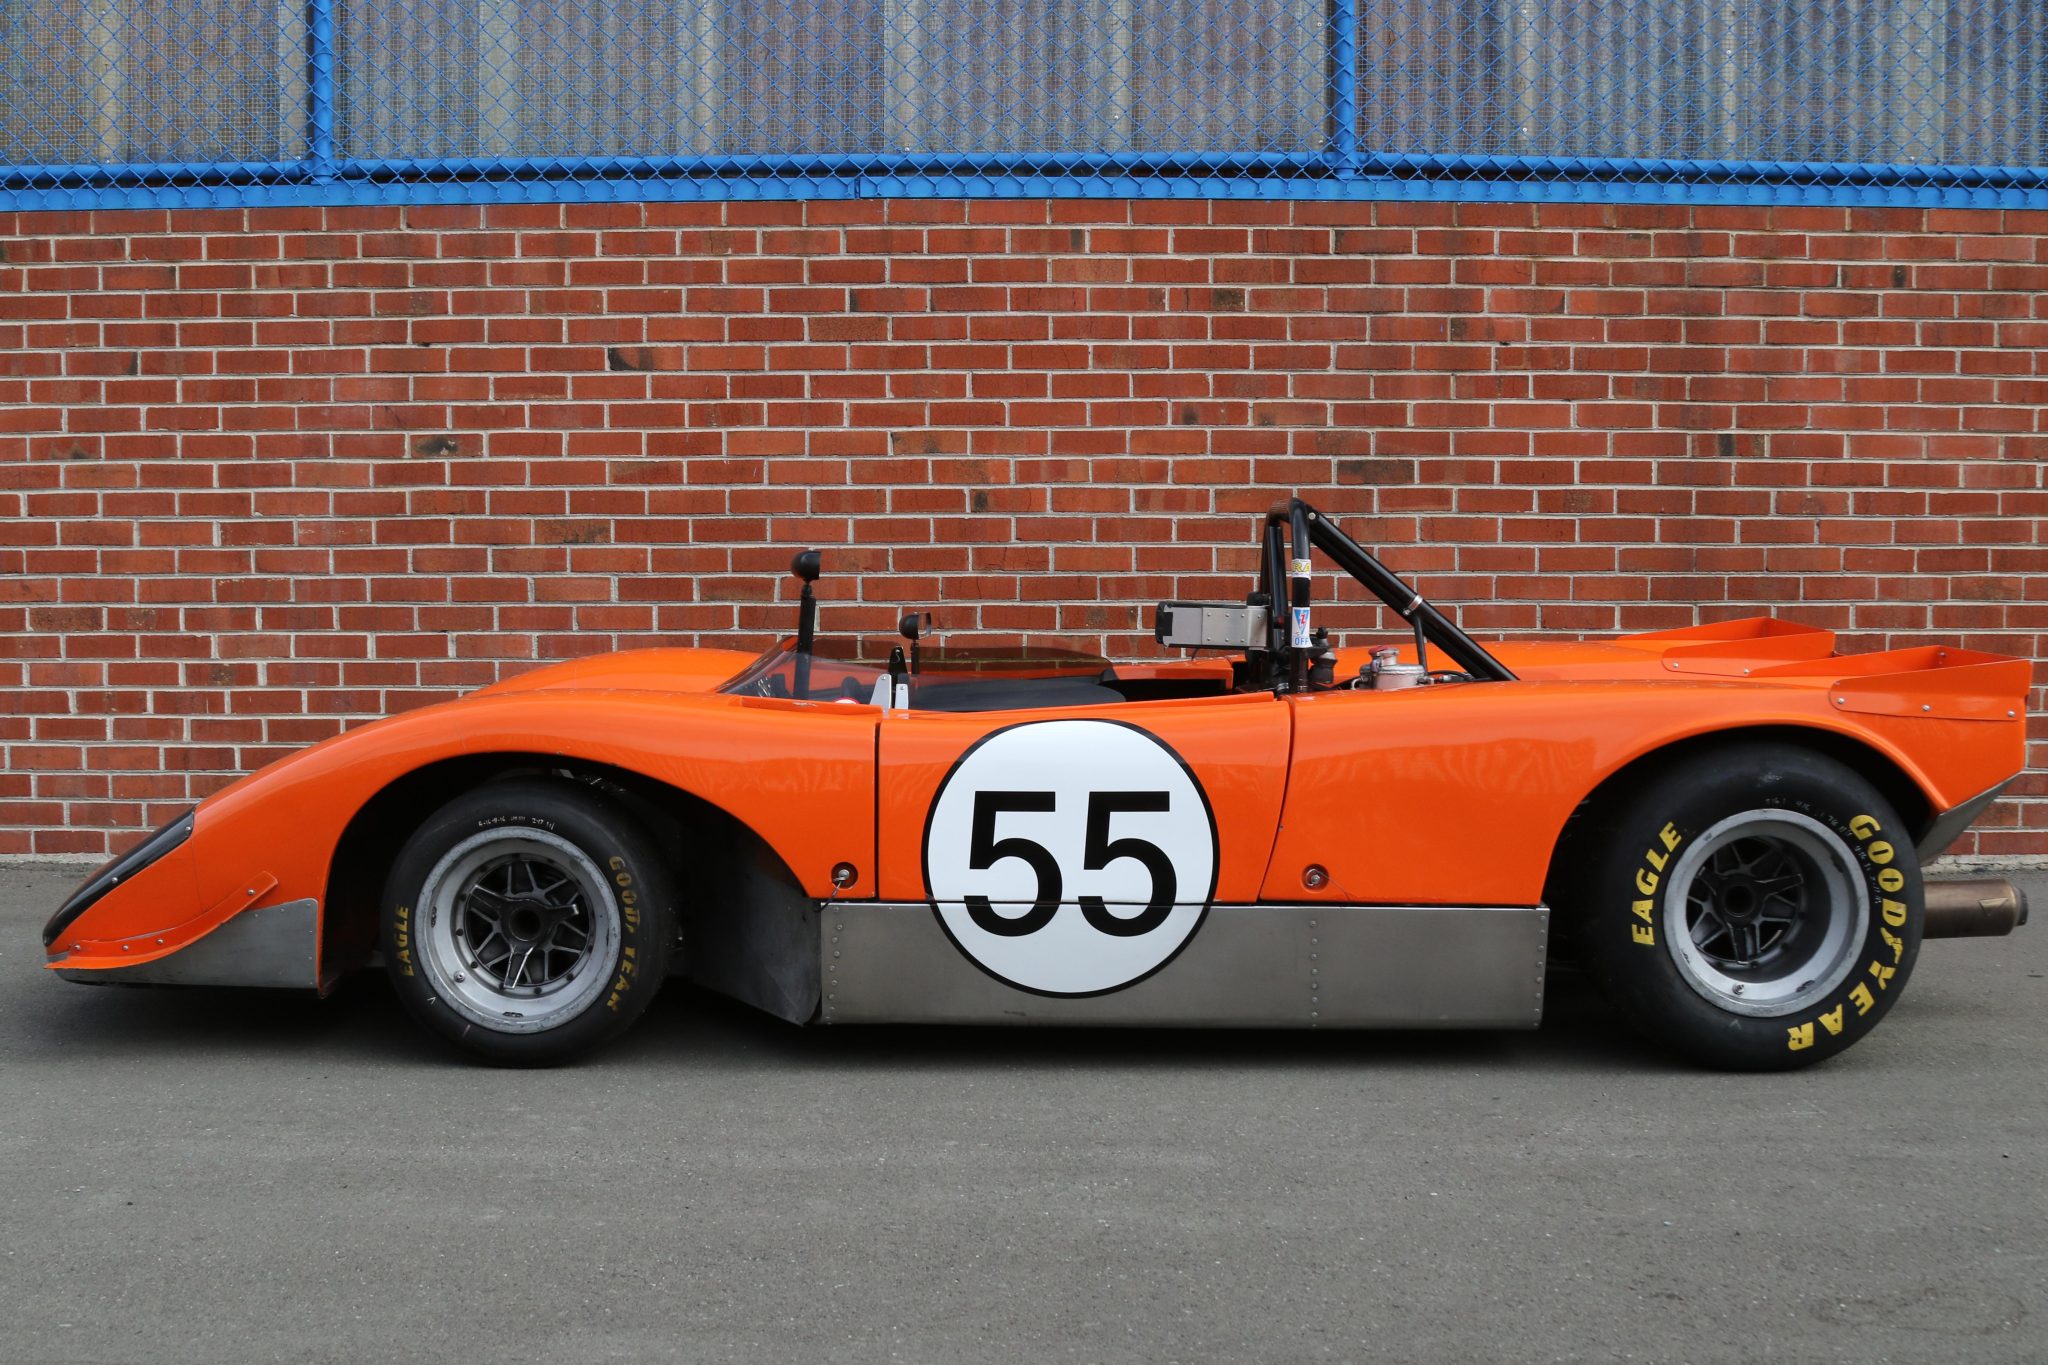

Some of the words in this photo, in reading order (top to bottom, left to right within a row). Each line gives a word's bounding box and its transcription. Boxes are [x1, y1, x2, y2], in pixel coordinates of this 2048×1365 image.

[964, 791, 1177, 937] 55
[1631, 820, 1682, 947] EAGLE
[395, 904, 415, 977] EAGLE
[1787, 814, 1907, 1051] GOODYEAR
